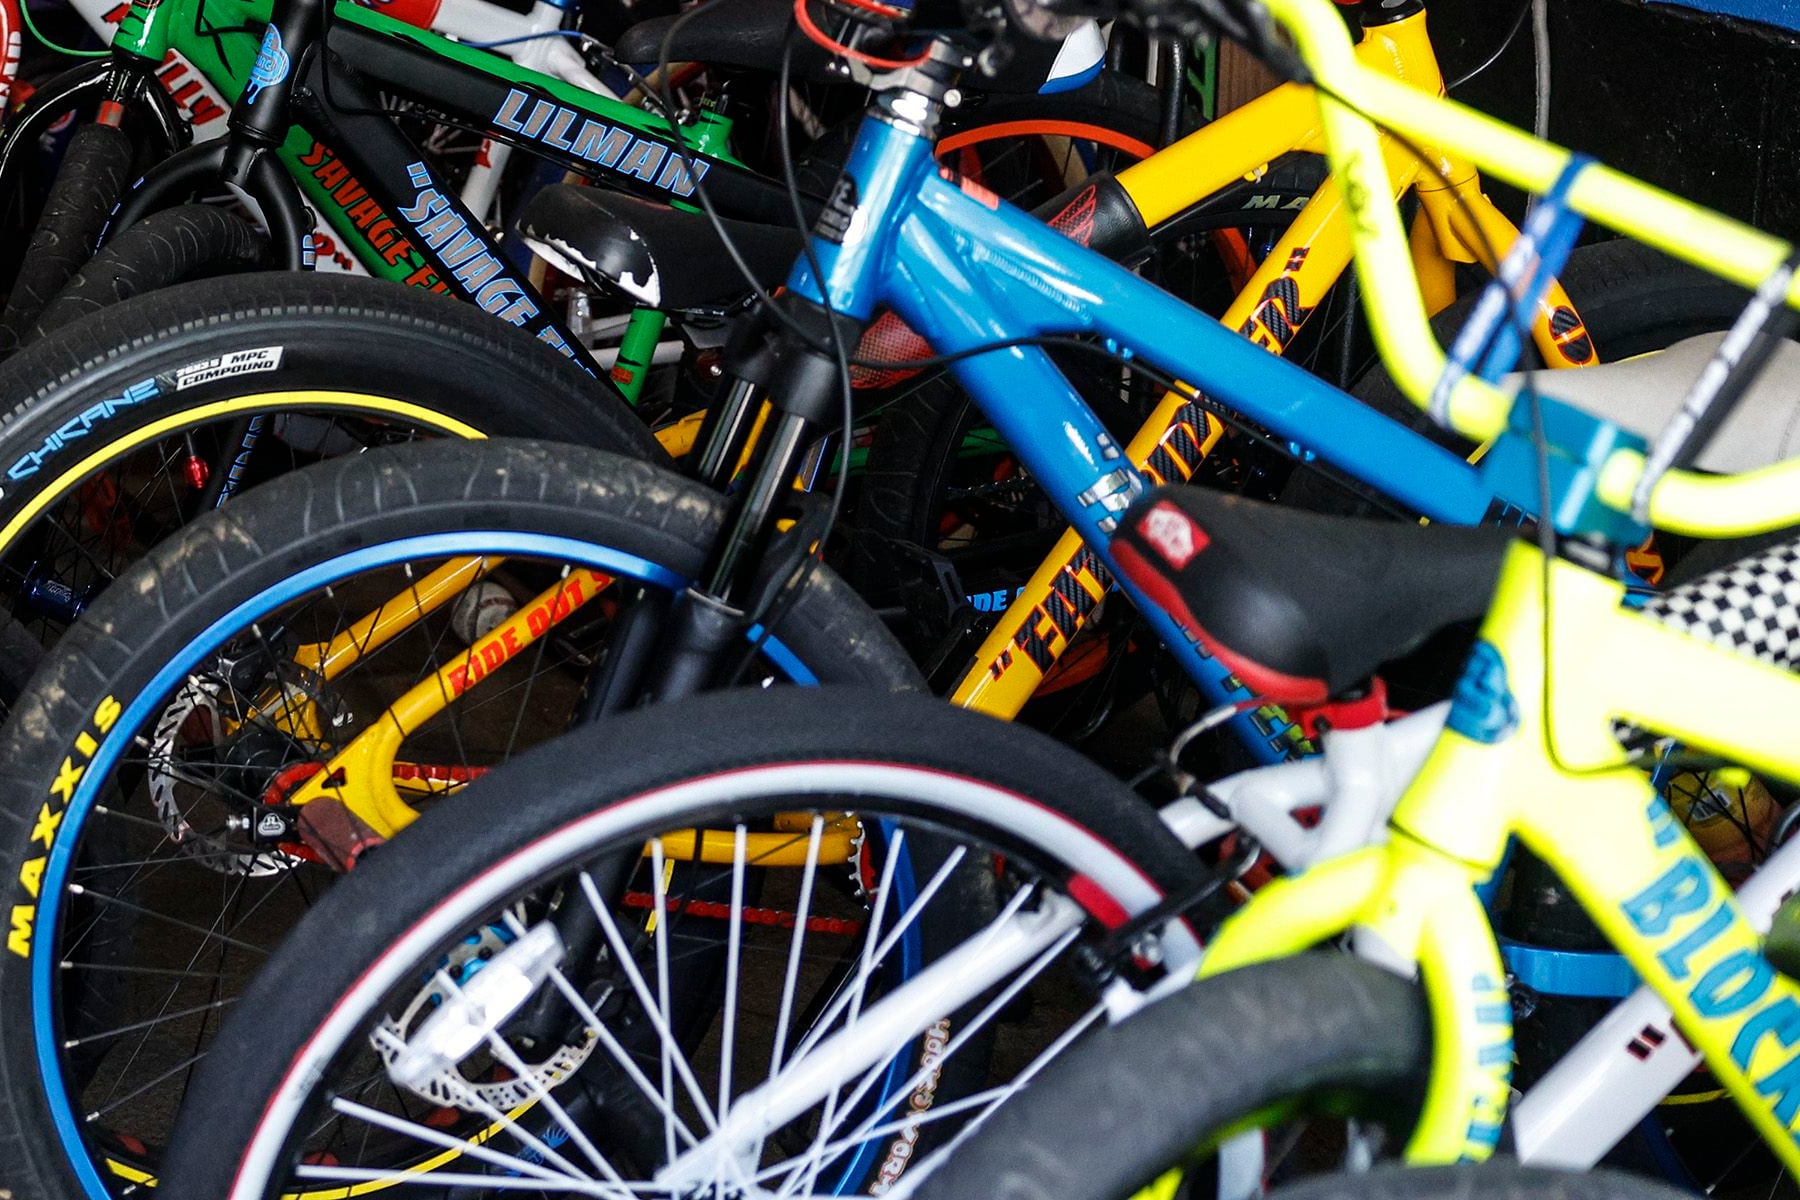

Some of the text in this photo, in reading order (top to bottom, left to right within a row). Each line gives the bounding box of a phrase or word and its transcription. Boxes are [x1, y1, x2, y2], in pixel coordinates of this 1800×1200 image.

[492, 88, 711, 198] LILMAN
[299, 141, 416, 267] SAVAGE
[182, 359, 275, 388] COMPOUND
[230, 350, 271, 366] MPC
[7, 377, 163, 482] CHICANE
[448, 578, 584, 697] RIDE OUT
[7, 695, 121, 958] MAXXIS
